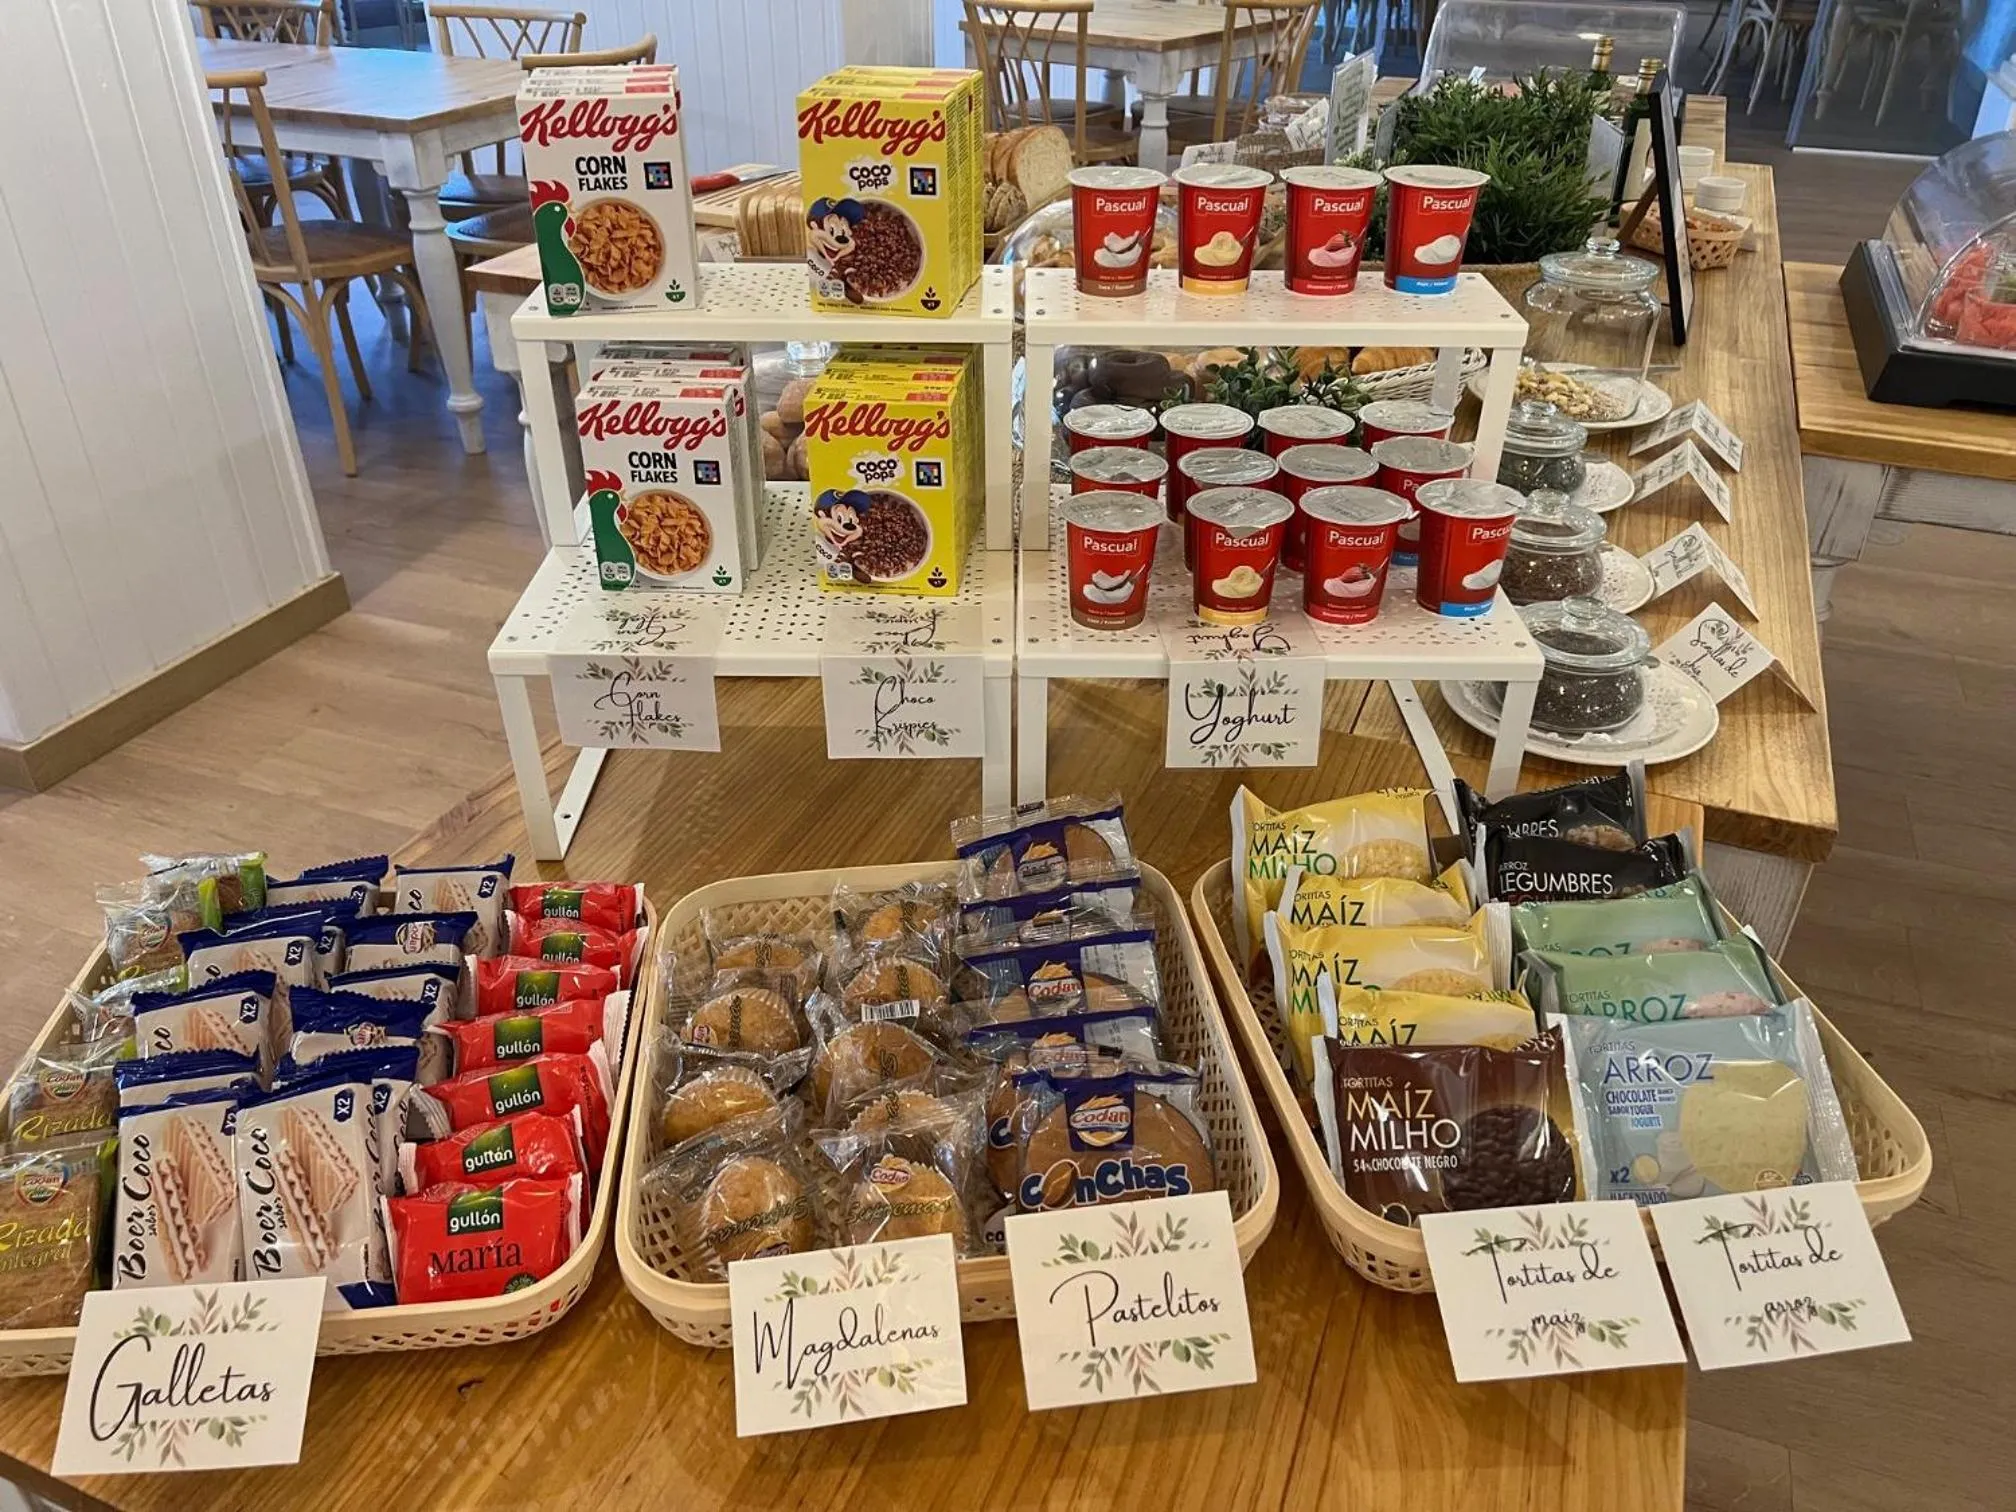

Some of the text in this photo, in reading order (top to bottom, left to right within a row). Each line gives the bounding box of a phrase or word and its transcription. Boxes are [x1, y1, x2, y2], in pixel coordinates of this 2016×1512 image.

[520, 98, 679, 153] Kellogg's
[798, 98, 946, 157] Kellogg's
[575, 156, 628, 175] CORN
[578, 176, 628, 191] FLAKES
[858, 176, 890, 191] pops
[1096, 197, 1147, 213] Pascual
[1198, 196, 1249, 212] Pascual
[1314, 196, 1365, 213] Pascual
[1423, 195, 1472, 211] Pascual
[577, 400, 727, 451] Kellogg's
[804, 401, 951, 451] Kellogg's
[628, 451, 677, 470] CORN
[631, 470, 678, 484] FLAKES
[864, 470, 895, 484] pops
[1215, 532, 1269, 548] Pascual
[1329, 531, 1384, 547] Pascual
[1472, 524, 1513, 540] Pascu
[1084, 536, 1137, 553] Pascual
[594, 672, 660, 709] Corn
[875, 676, 936, 714] Choco
[622, 697, 681, 728] Flakes
[1185, 683, 1296, 744] Yoghurt
[874, 710, 937, 740] Krispies
[1252, 822, 1286, 831] ORTITAS
[1249, 825, 1317, 856] MAÍZ
[481, 879, 494, 894] X2
[1500, 872, 1613, 895] LEGUMBRES
[544, 905, 579, 917] gullón
[1290, 895, 1367, 926] MAÍZ
[288, 944, 302, 962] X2
[319, 934, 333, 954] X2
[1289, 948, 1325, 962] ORTITAS
[1291, 952, 1362, 987] MAÍZ
[424, 982, 437, 999] X2
[240, 1000, 257, 1019] X2
[516, 994, 555, 1008] gullón
[1583, 994, 1688, 1022] ARROZ
[1336, 1018, 1418, 1045] MAÍZ
[1338, 1015, 1380, 1028] ORTITAS
[496, 1040, 541, 1058] gullón
[1604, 1053, 1715, 1084] ARROZ
[1342, 1075, 1393, 1088] TORTITAS
[336, 1096, 351, 1116] X2
[373, 1089, 389, 1108] X2
[495, 1089, 542, 1114] gullón
[1347, 1081, 1436, 1121] MAÍZ
[1606, 1089, 1657, 1104] CHOCOLATE
[1351, 1118, 1461, 1151] MILHO
[465, 1147, 514, 1173] gullón
[1425, 1154, 1458, 1169] NEGRO
[1610, 1166, 1631, 1184] x2
[118, 1133, 152, 1281] Boer Coco
[246, 1127, 282, 1278] Boer Coco
[449, 1204, 501, 1232] gullón
[430, 1236, 523, 1275] María
[1697, 1224, 1843, 1291] Tortitas de
[1463, 1237, 1619, 1304] Tortitas de
[1049, 1270, 1221, 1347] Pastelitos
[754, 1297, 940, 1390] Magdalenas
[90, 1334, 276, 1441] Galletas
